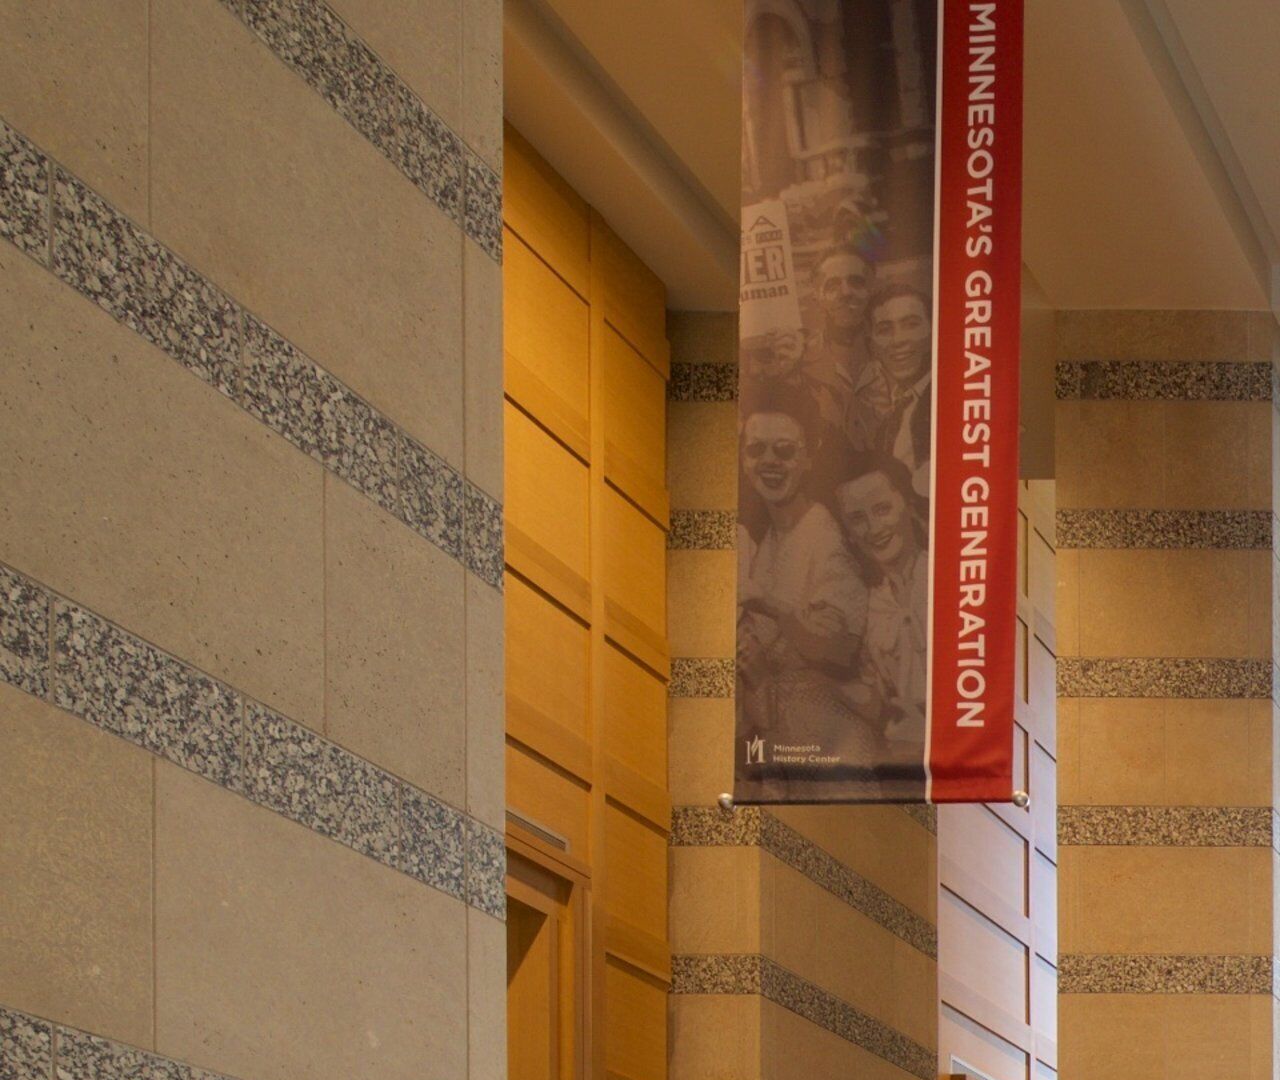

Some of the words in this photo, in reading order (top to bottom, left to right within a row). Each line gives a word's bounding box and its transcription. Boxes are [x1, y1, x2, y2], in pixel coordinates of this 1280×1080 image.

[965, 2, 997, 259] MINNESOTA'S
[962, 269, 994, 468] GREATEST
[955, 476, 991, 728] GENERATION
[773, 744, 821, 753] Minnesota
[773, 754, 807, 764] History
[808, 754, 841, 763] Center
